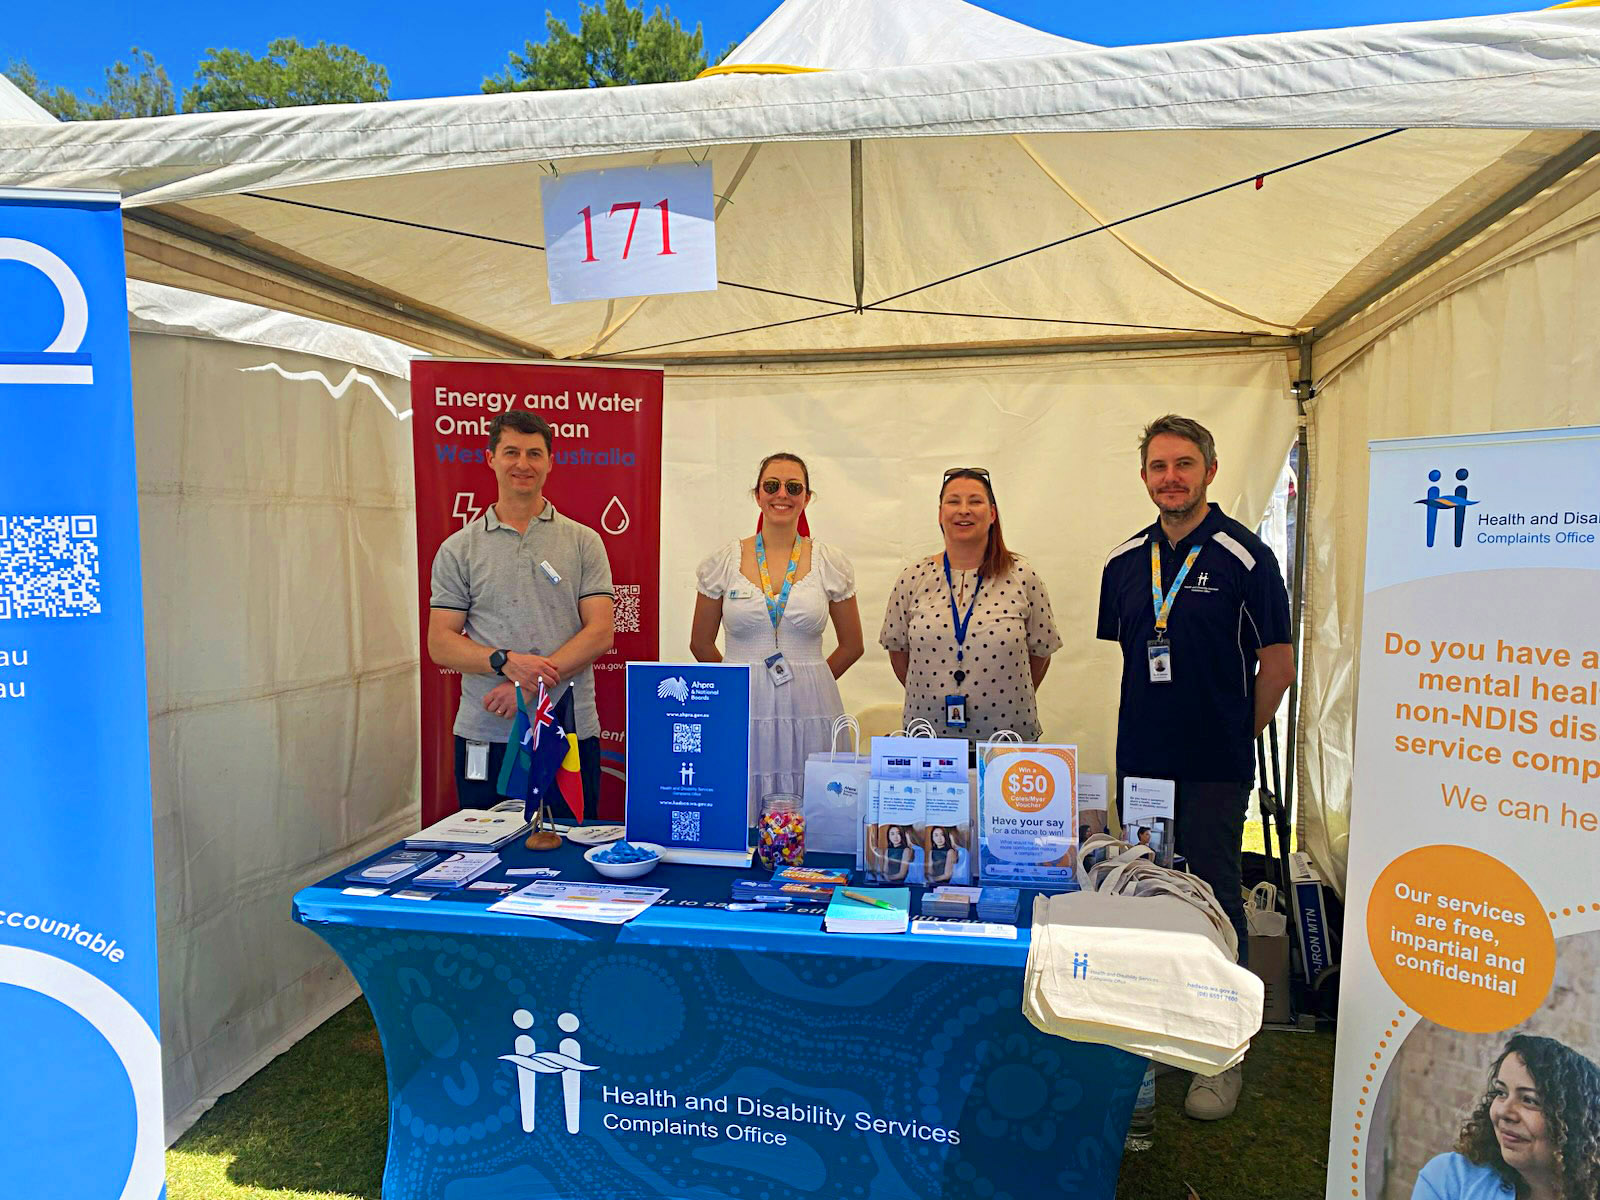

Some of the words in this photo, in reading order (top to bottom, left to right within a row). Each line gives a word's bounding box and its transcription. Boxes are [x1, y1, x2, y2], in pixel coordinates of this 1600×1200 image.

[577, 198, 678, 263] 171
[434, 387, 517, 412] Energy
[524, 392, 569, 410] and
[577, 392, 642, 412] Water
[435, 415, 589, 438] Ombman
[555, 447, 636, 467] ustralia
[1478, 513, 1525, 526] Health
[1530, 512, 1558, 525] and
[1564, 511, 1600, 525] Disa
[1477, 532, 1551, 546] Complaints
[1555, 531, 1595, 544] Office
[1385, 632, 1421, 656] Do
[1430, 640, 1485, 663] you
[1497, 639, 1571, 667] have
[1581, 651, 1599, 669] a
[691, 681, 715, 689] Ahpra
[1419, 672, 1520, 698] mental
[1532, 676, 1600, 706] heal
[1396, 703, 1538, 734] non-NDIS
[1550, 714, 1600, 742] dis
[1395, 735, 1501, 765] service
[1008, 773, 1047, 794] $50
[1441, 783, 1487, 812] We
[1498, 798, 1549, 823] can
[992, 815, 1017, 825] Have
[1019, 817, 1043, 829] your
[1046, 819, 1065, 829] say
[1011, 828, 1038, 836] chance
[1395, 883, 1431, 904] Our
[1437, 894, 1526, 926] services
[1305, 907, 1320, 934] MTN
[1416, 912, 1447, 931] are
[1453, 918, 1500, 947] free,
[1391, 926, 1478, 962] impartial
[1485, 953, 1525, 975] and
[1395, 953, 1517, 996] confidential
[602, 1085, 677, 1108] Health
[685, 1092, 728, 1114] and
[737, 1097, 846, 1132] Disability
[854, 1111, 961, 1145] Services
[603, 1113, 718, 1139] Complaints
[725, 1123, 787, 1146] Office
